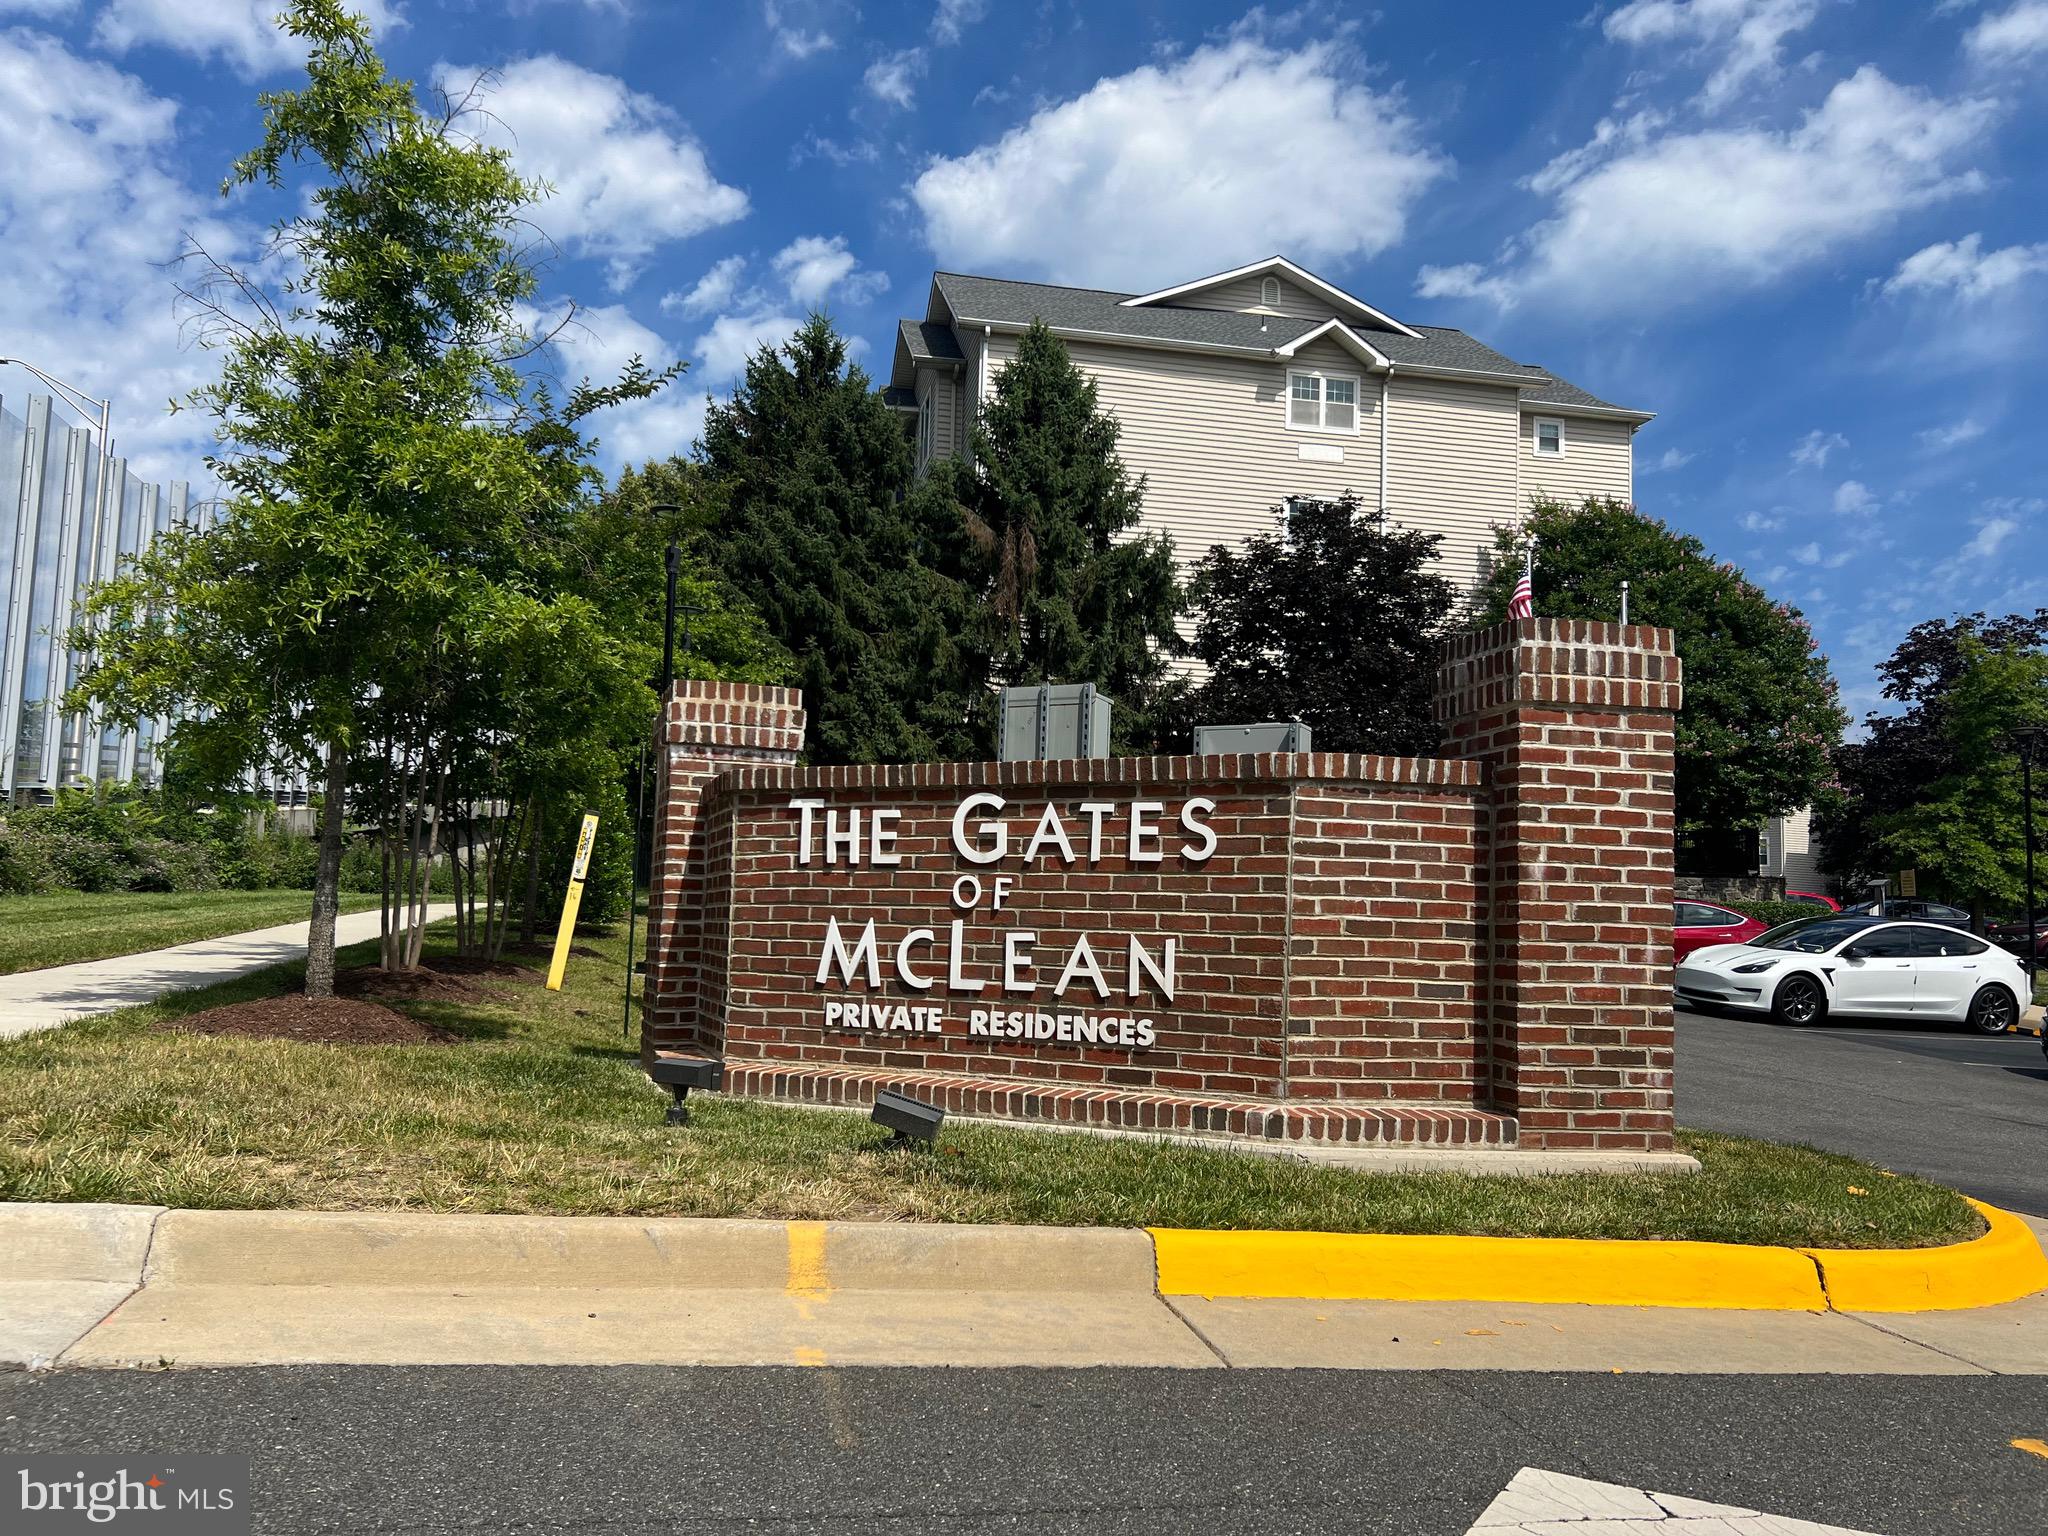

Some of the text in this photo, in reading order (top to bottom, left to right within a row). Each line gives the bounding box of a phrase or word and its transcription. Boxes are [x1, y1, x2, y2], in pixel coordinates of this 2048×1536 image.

[788, 792, 1218, 865] THE GATES
[952, 874, 1013, 910] OF
[825, 1001, 1155, 1047] PRIVATE RESIDENCES
